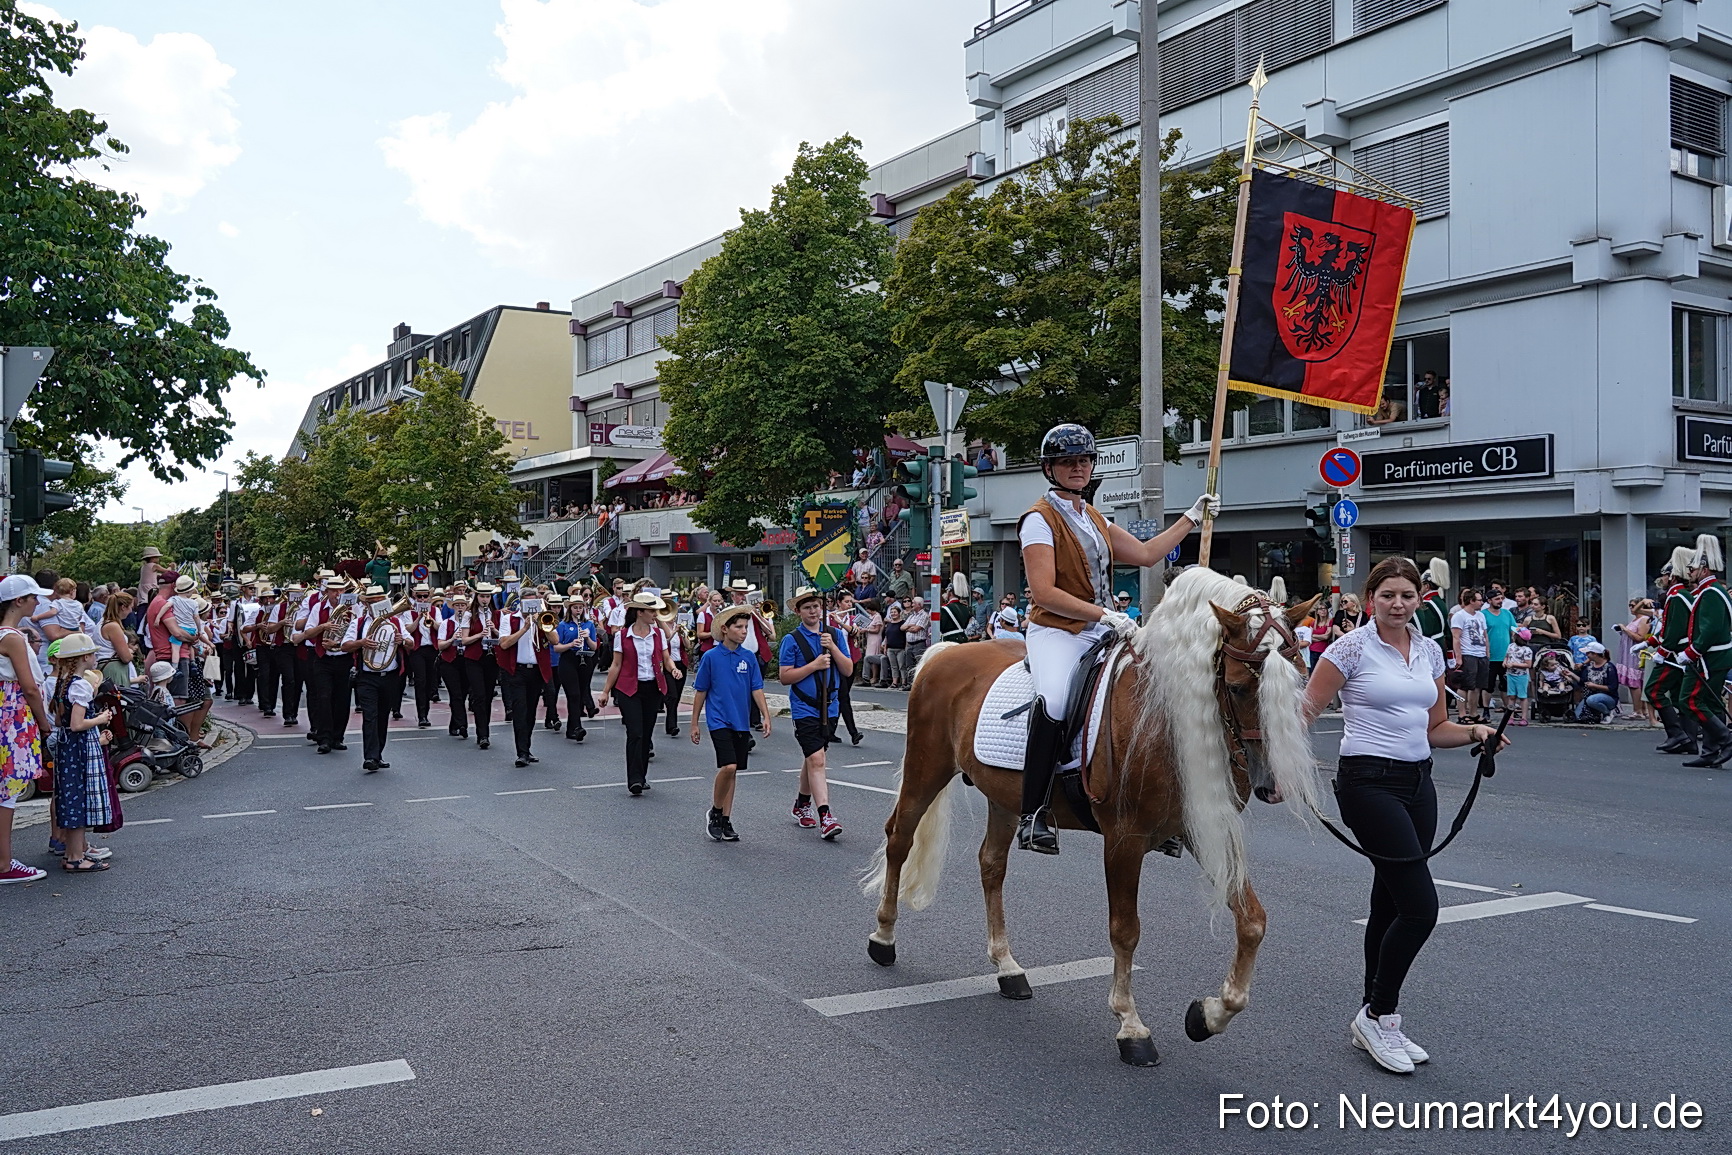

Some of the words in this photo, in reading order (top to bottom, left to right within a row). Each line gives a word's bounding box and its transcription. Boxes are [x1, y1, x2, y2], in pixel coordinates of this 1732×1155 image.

[497, 420, 540, 440] TEL
[1094, 450, 1126, 466] ahnhof
[1384, 457, 1473, 479] Parfümerie
[1481, 446, 1518, 472] CB
[1102, 490, 1140, 502] Bahnhofstraße
[762, 530, 798, 548] Apothe
